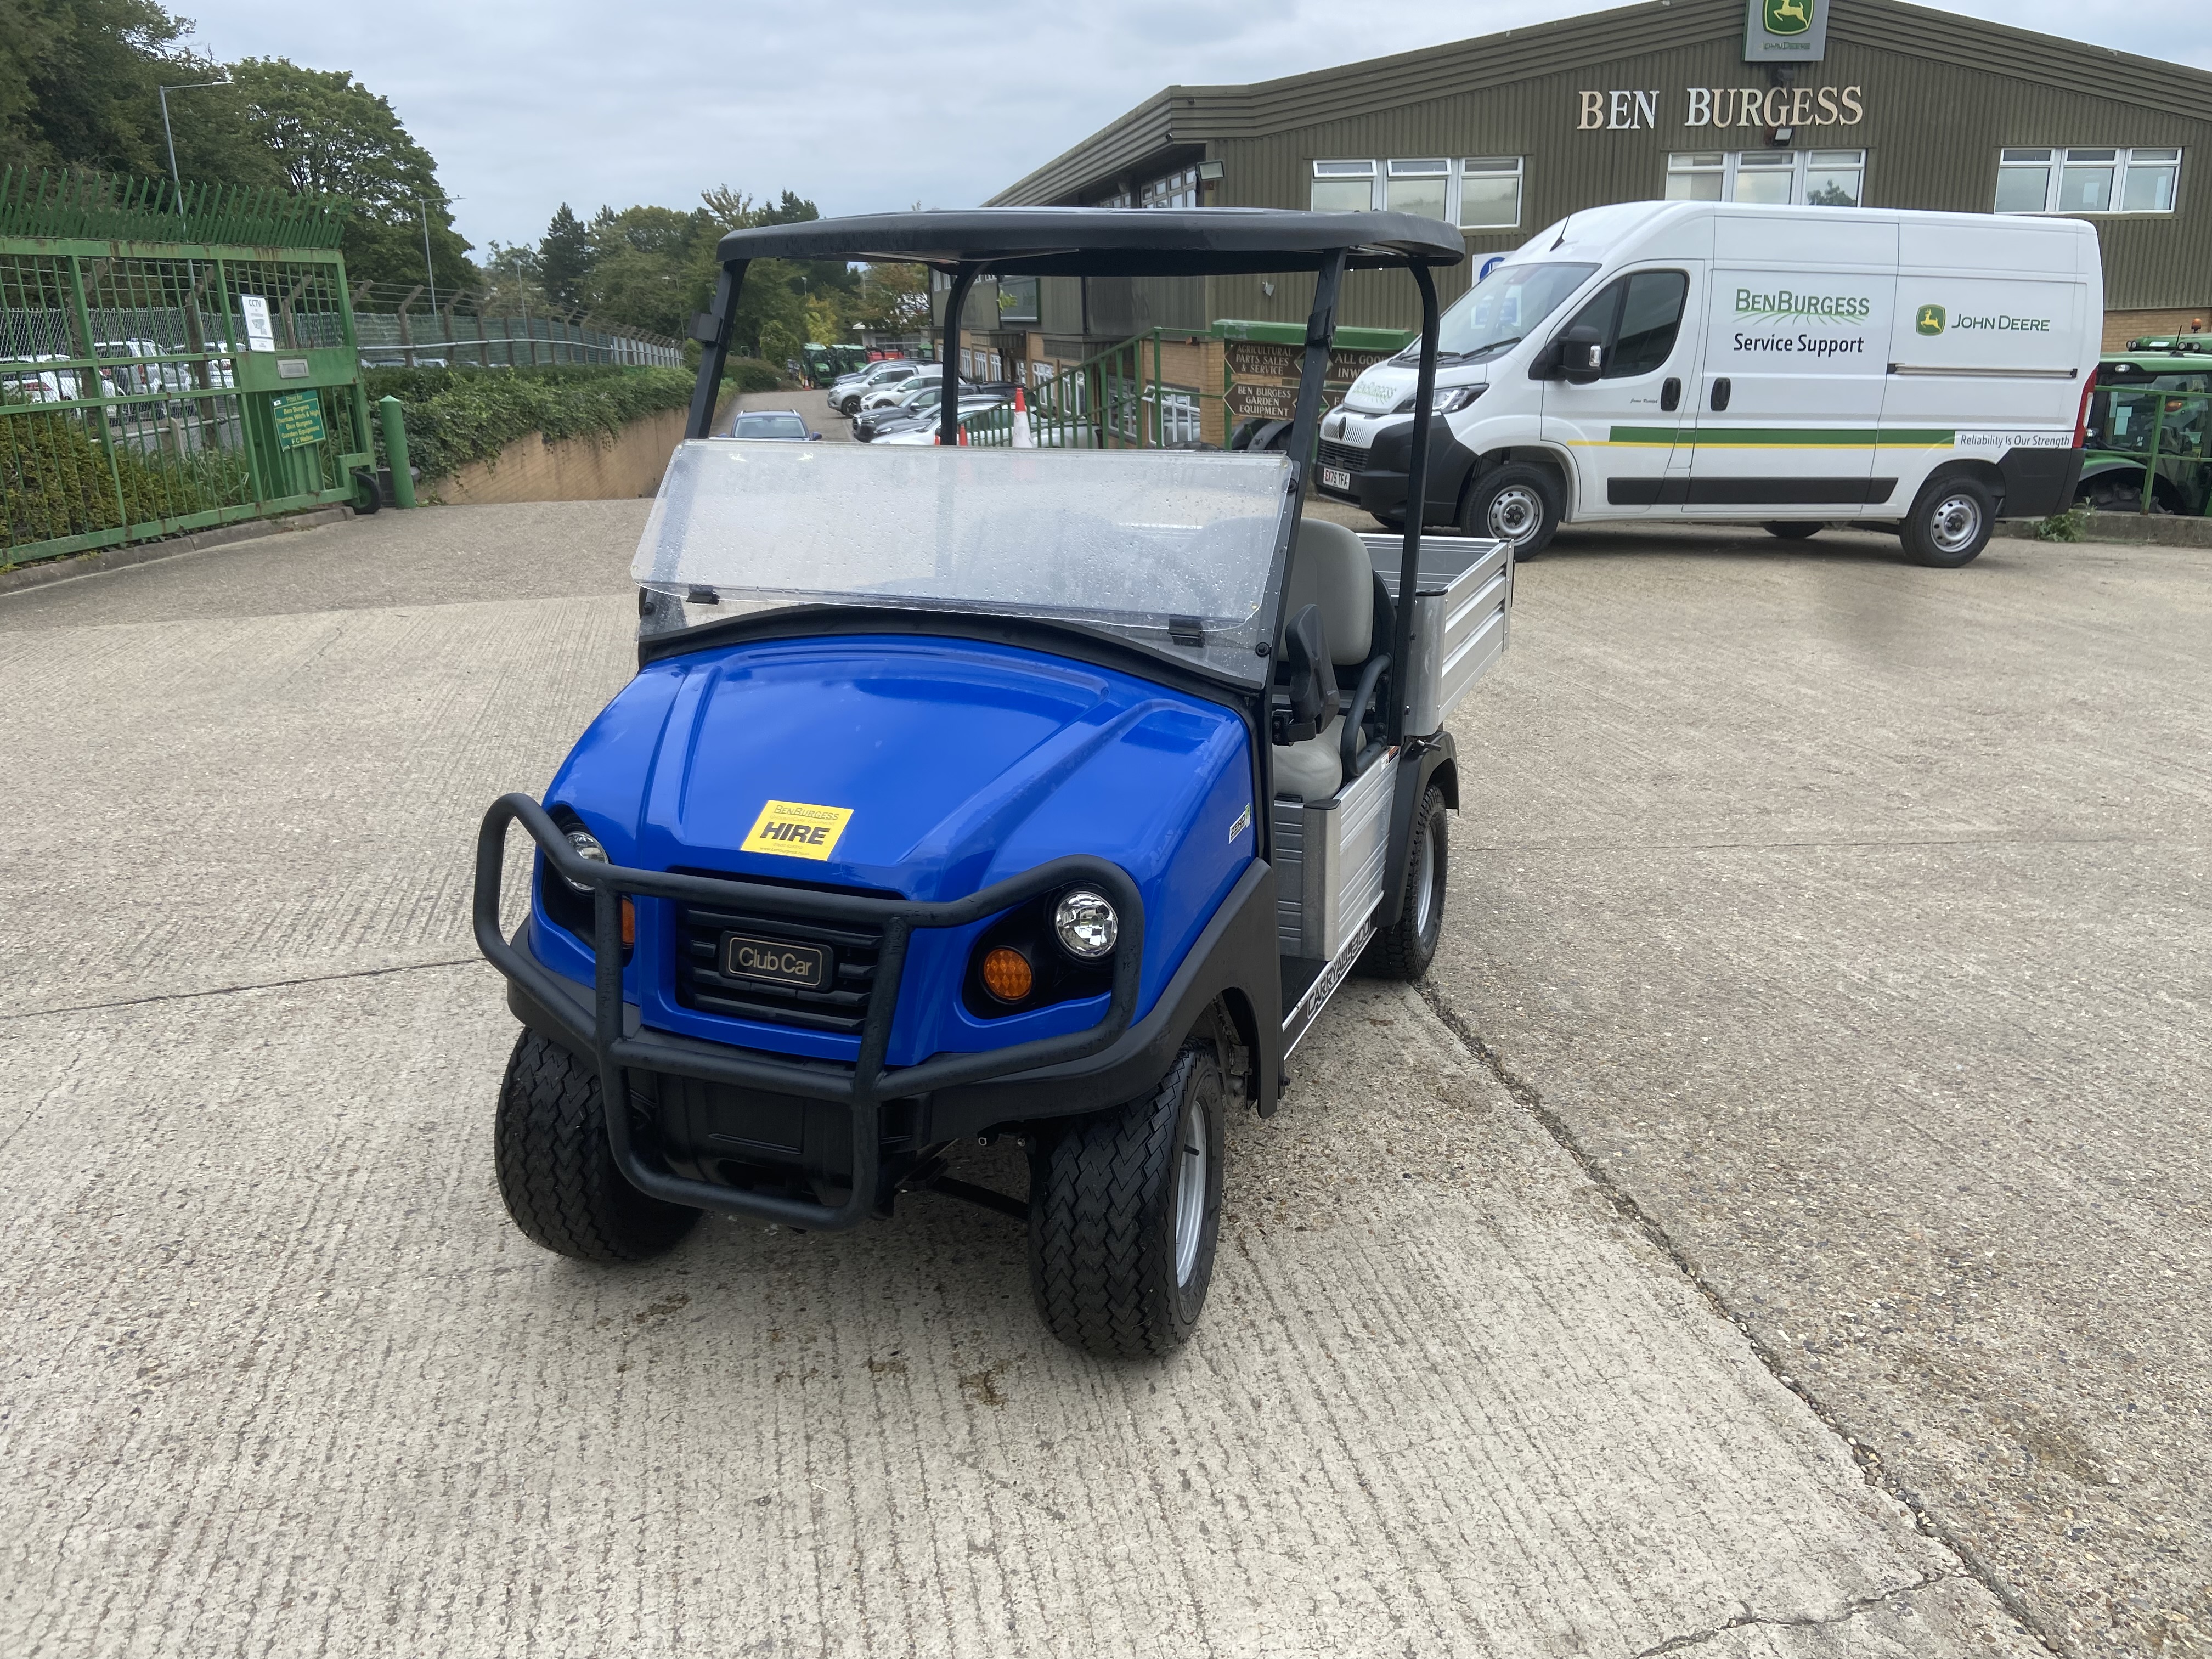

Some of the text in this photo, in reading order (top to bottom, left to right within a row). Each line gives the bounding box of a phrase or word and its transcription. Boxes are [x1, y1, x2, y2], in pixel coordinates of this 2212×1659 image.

[1577, 86, 1863, 130] BEN BURGESS
[249, 299, 261, 307] CCTV
[1951, 313, 2050, 331] JOHN DEERE
[1237, 345, 1293, 357] AGRICULTURAL
[1734, 332, 1864, 358] Service Support
[1263, 356, 1289, 366] SALES
[1335, 353, 1389, 365] ALL GOO
[1250, 364, 1284, 375] SERVICE
[1238, 386, 1291, 398] BEN BURGESS
[1245, 396, 1279, 407] GARDEN
[1239, 404, 1289, 416] EQUIPMENT
[1961, 434, 2069, 448] Reliability Is Our Strength
[760, 821, 831, 845] HIRE
[739, 947, 812, 976] Club Car
